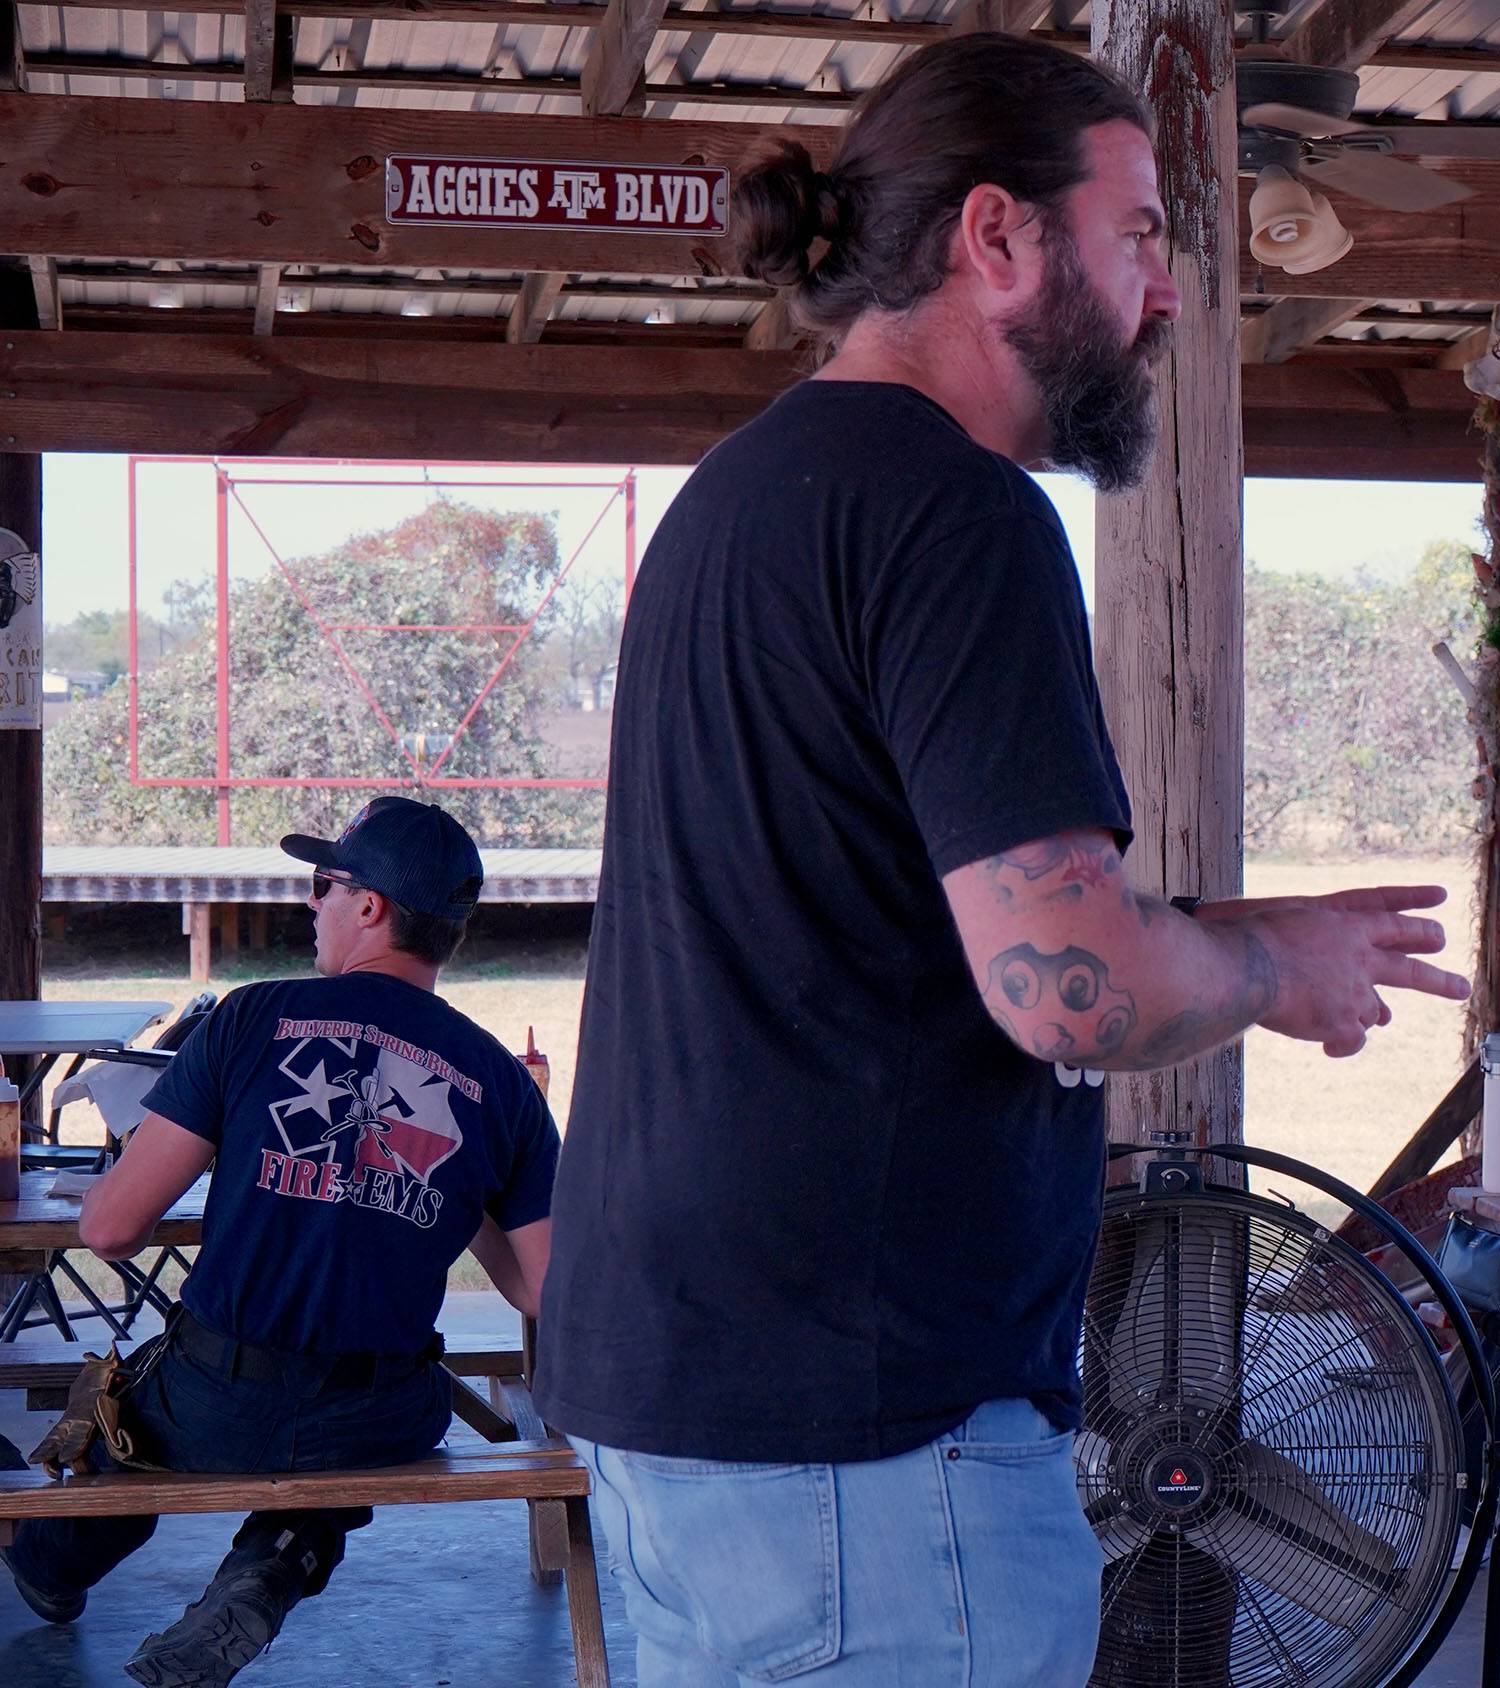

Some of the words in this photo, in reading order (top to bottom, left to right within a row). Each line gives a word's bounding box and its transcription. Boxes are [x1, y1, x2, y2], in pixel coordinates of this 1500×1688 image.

[406, 165, 540, 218] AGGIES
[615, 173, 709, 224] BLVD
[274, 1018, 363, 1040] BULVERDE
[364, 1024, 426, 1065] SPRING
[427, 1050, 483, 1104] BRANCH
[257, 1148, 342, 1202] FIRE
[357, 1166, 444, 1228] EMS
